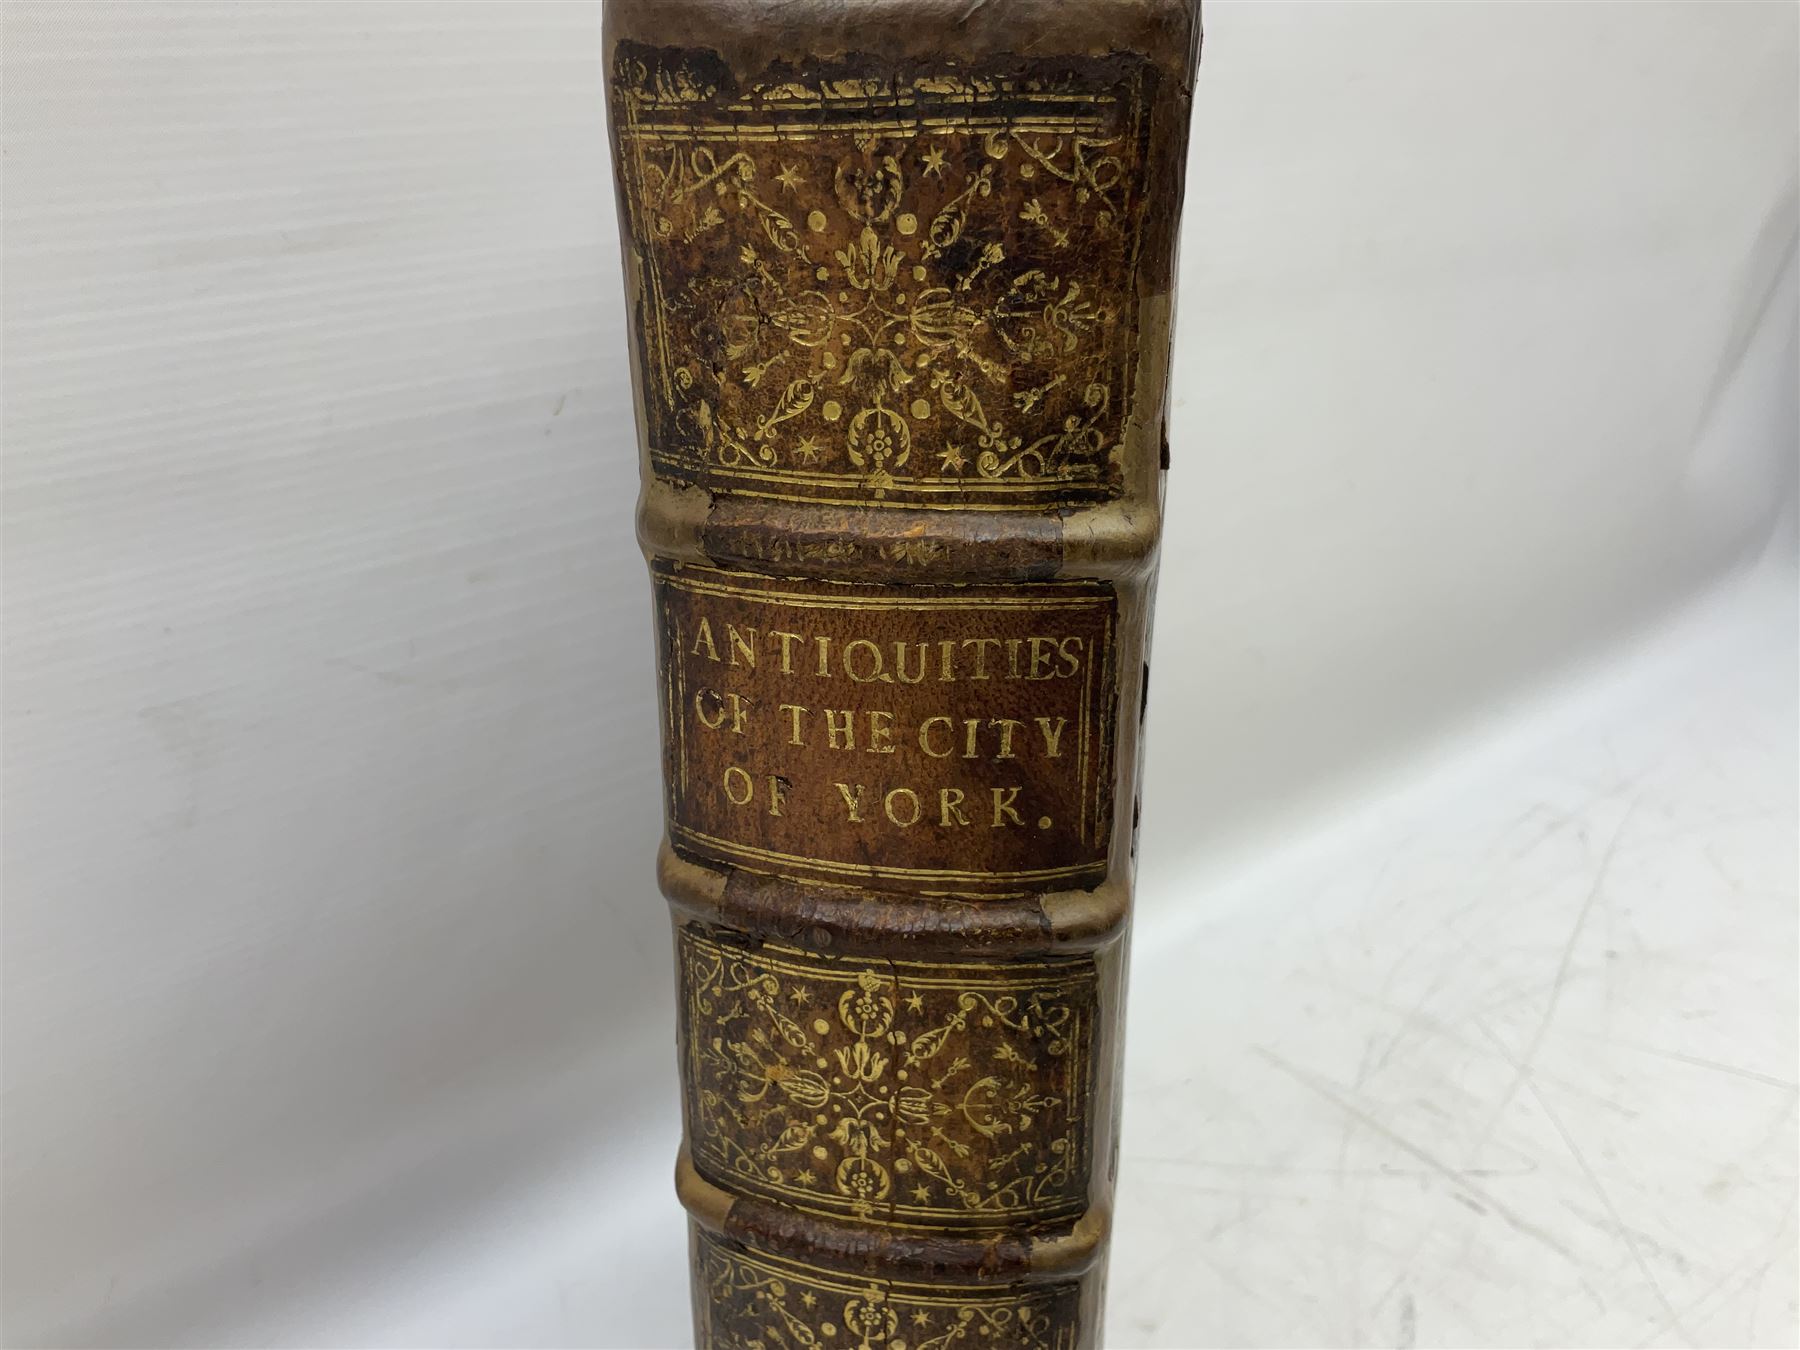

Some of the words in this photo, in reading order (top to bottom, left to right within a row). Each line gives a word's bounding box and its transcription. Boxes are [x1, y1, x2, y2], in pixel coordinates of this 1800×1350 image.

[691, 616, 1084, 684] ANTIQUITIES
[695, 687, 755, 735] OF
[779, 704, 897, 754] THE
[918, 716, 1070, 759] CITY
[723, 766, 793, 818] OF
[834, 782, 1054, 830] YORK.
